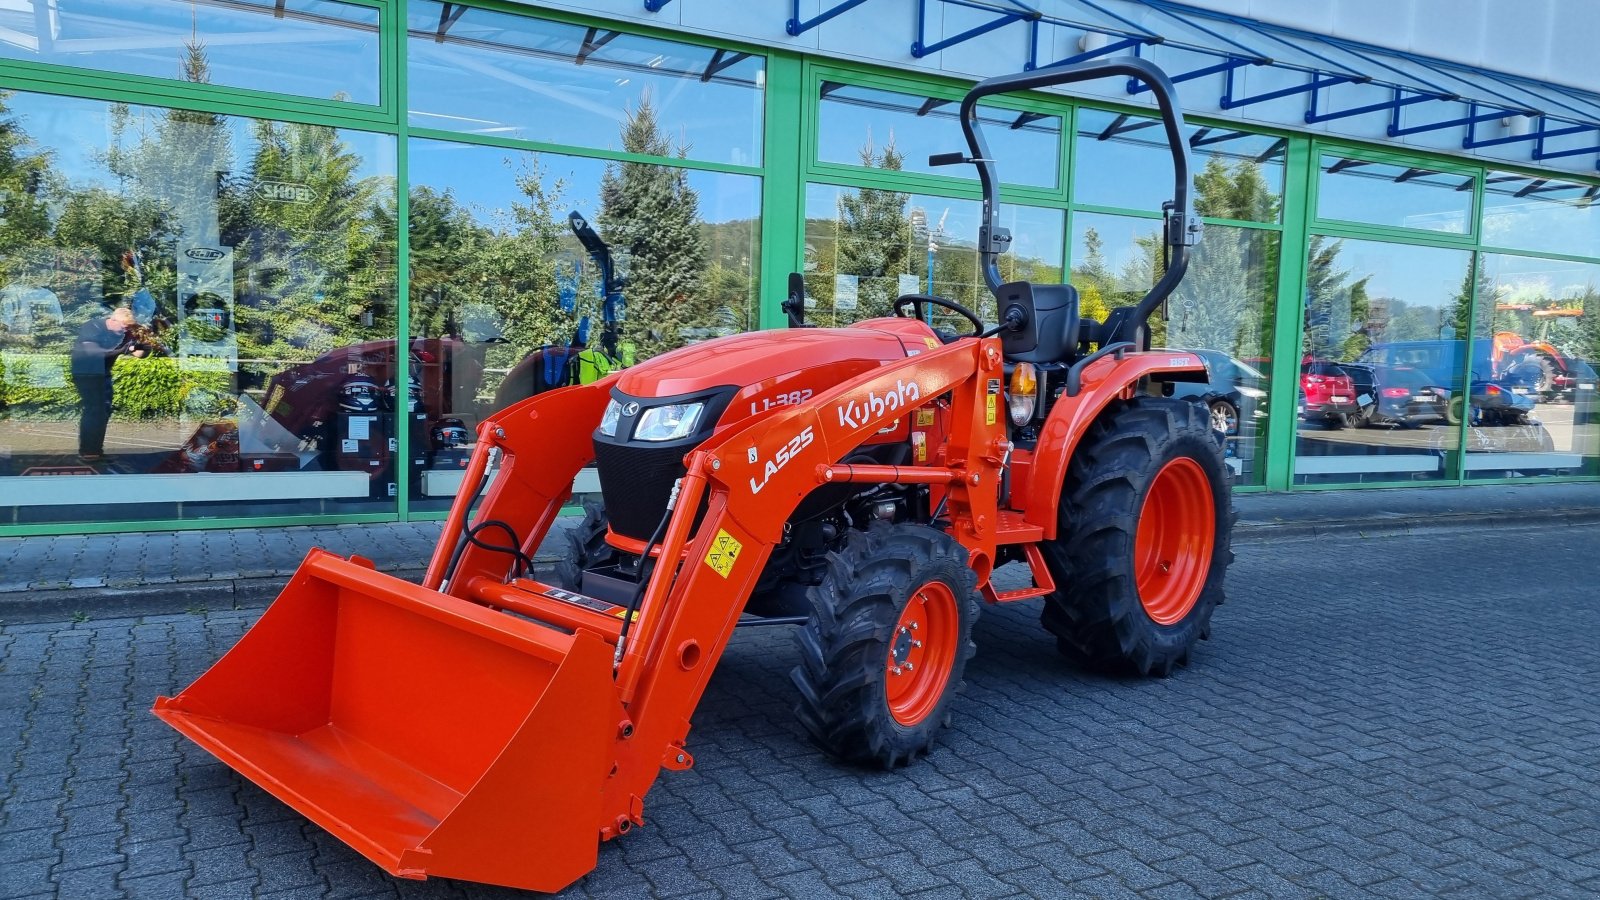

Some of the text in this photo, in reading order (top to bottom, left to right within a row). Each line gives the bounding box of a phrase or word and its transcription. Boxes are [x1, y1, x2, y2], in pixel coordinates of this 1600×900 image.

[263, 184, 309, 202] SHOEI
[751, 389, 813, 416] L1-382
[838, 379, 920, 429] Kubota
[749, 425, 814, 495] LA525
